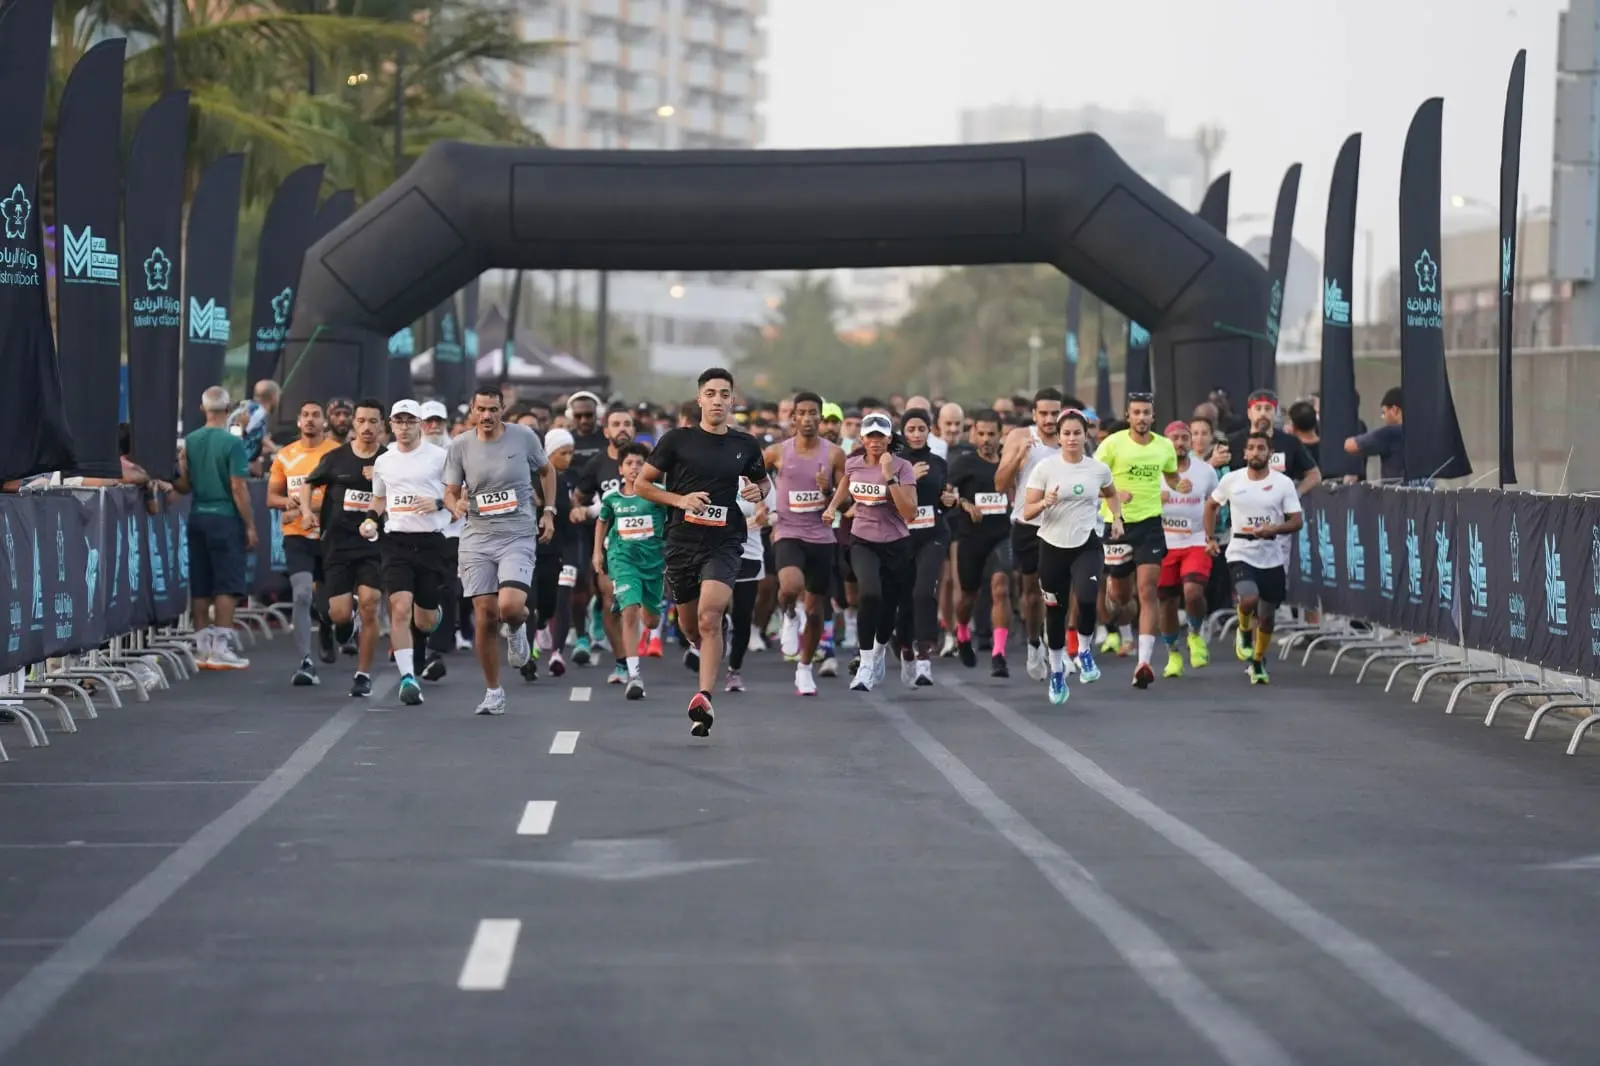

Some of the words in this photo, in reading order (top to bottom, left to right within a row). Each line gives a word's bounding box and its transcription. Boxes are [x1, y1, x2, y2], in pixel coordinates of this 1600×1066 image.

[853, 485, 880, 495] 6308
[482, 491, 509, 504] 1230
[625, 518, 644, 528] 229
